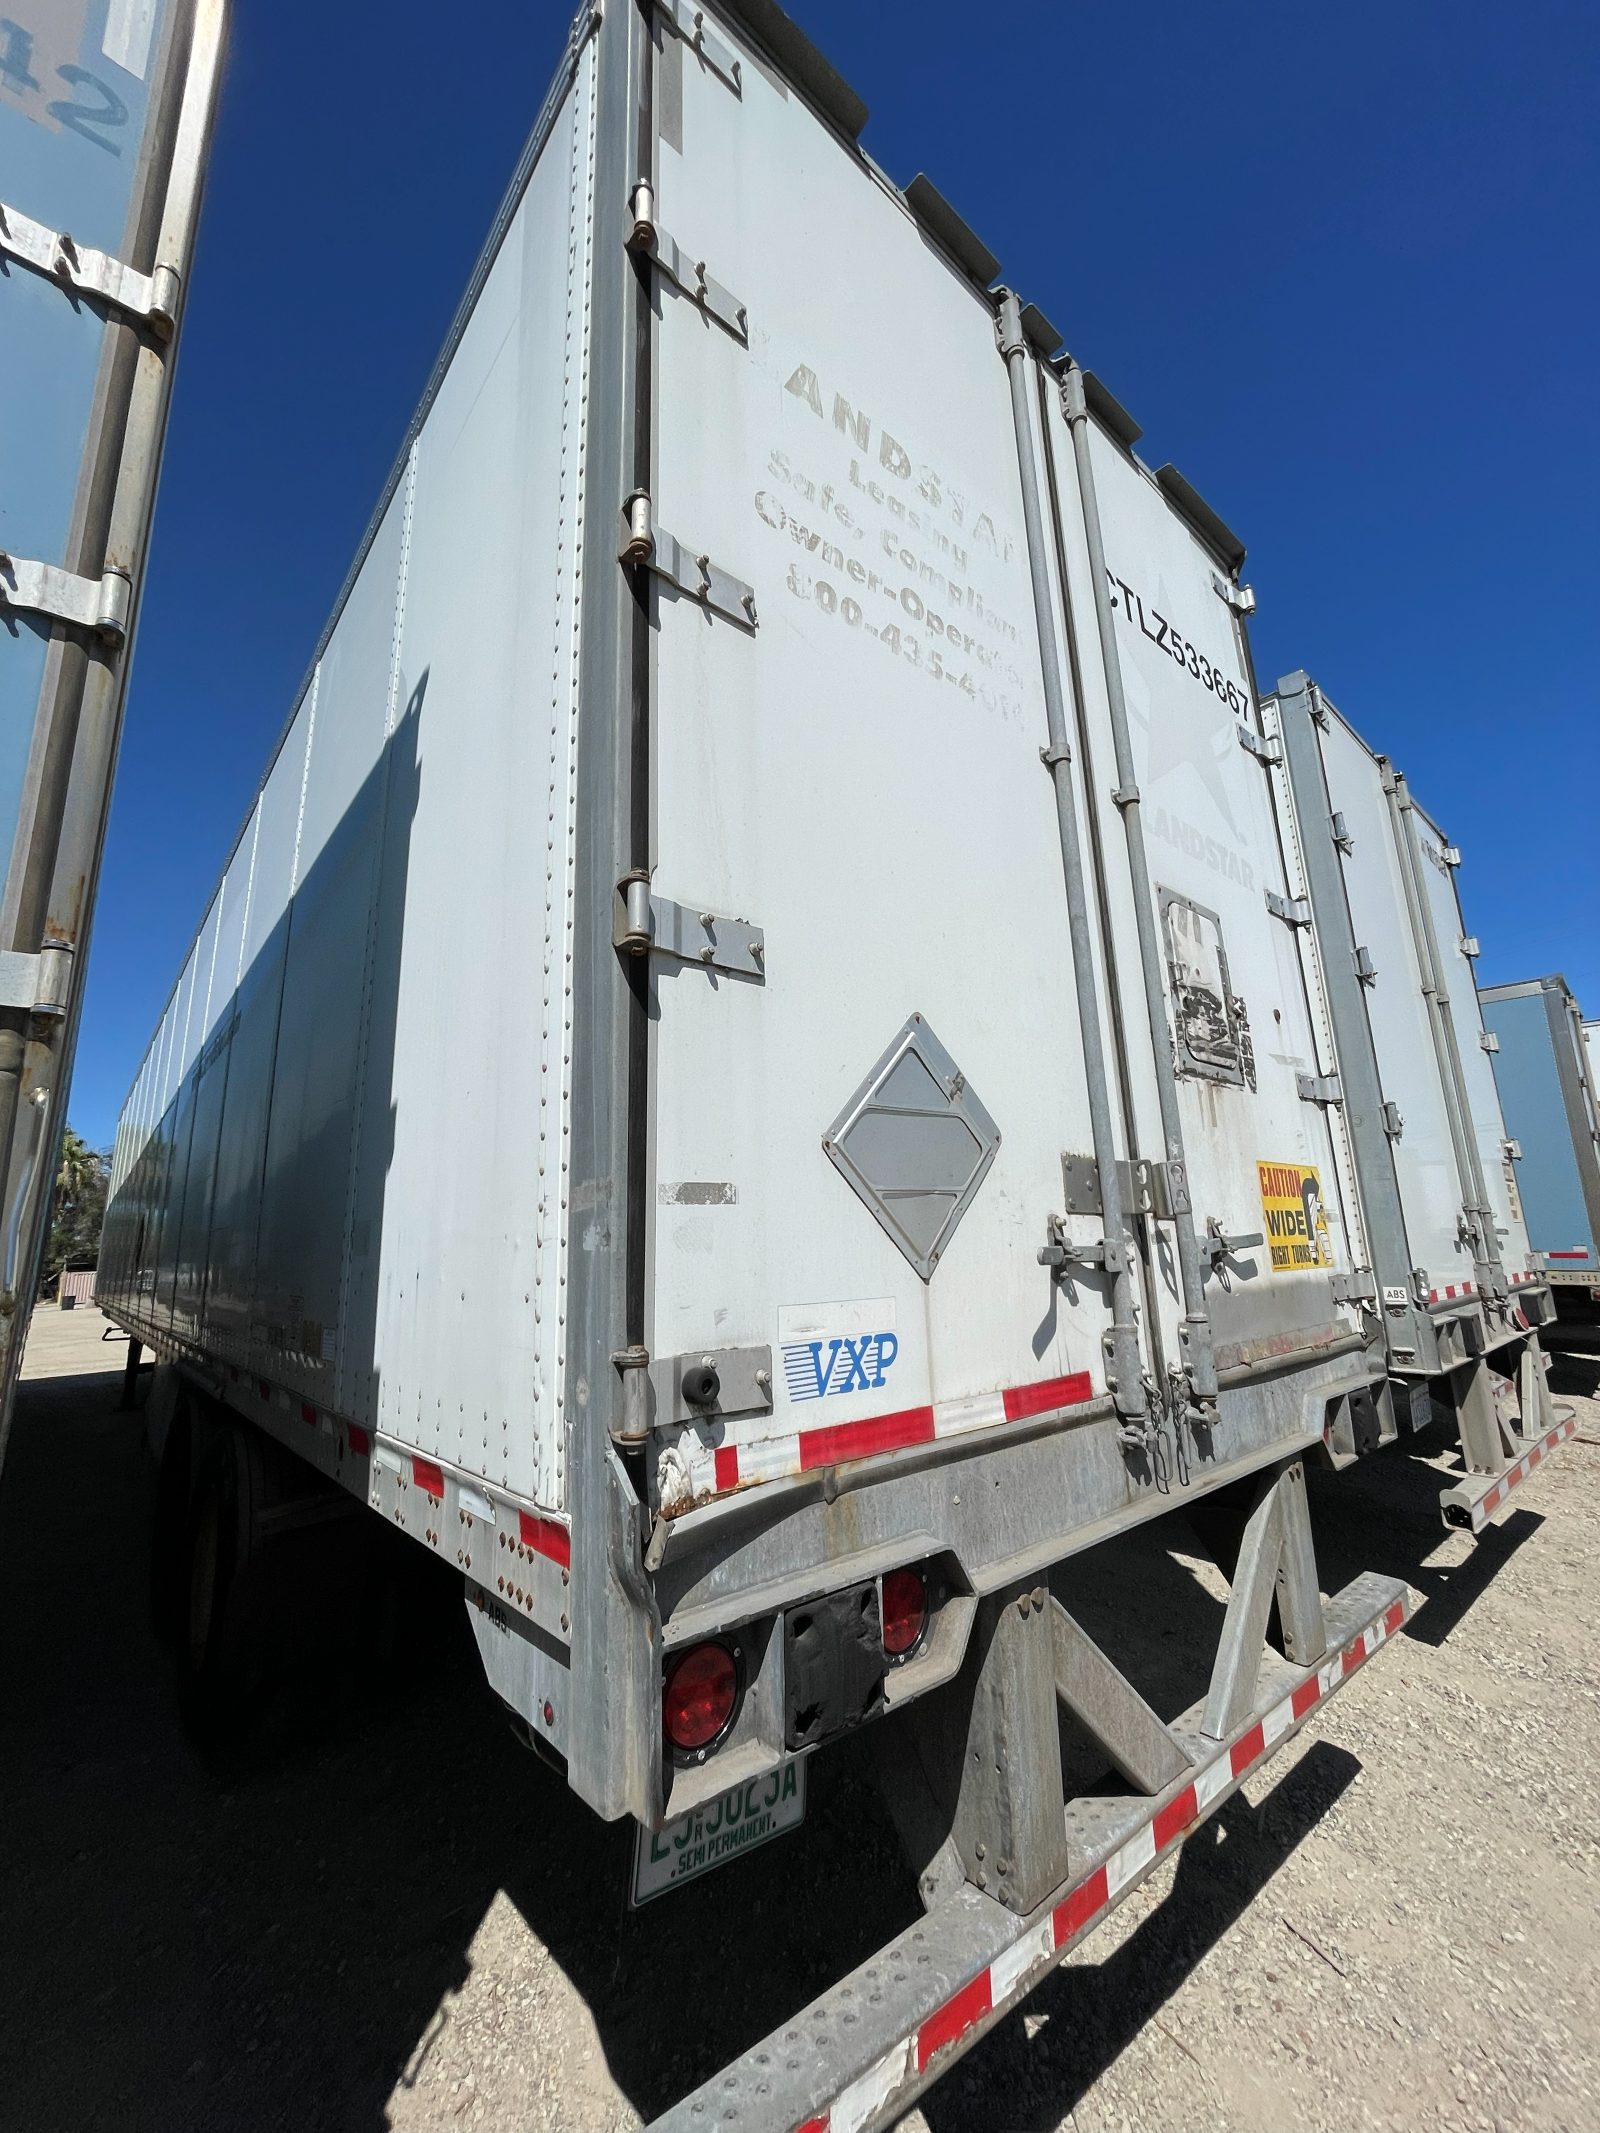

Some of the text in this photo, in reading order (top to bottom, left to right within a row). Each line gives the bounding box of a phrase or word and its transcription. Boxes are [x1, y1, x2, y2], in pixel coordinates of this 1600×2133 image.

[1258, 1166, 1303, 1198] CAUTION
[1265, 1209, 1307, 1237] WIDE
[1271, 1245, 1291, 1266] RIGHT
[1386, 1289, 1406, 1299] ABS
[807, 1332, 898, 1398] VXP
[678, 1844, 706, 1875] SEMI
